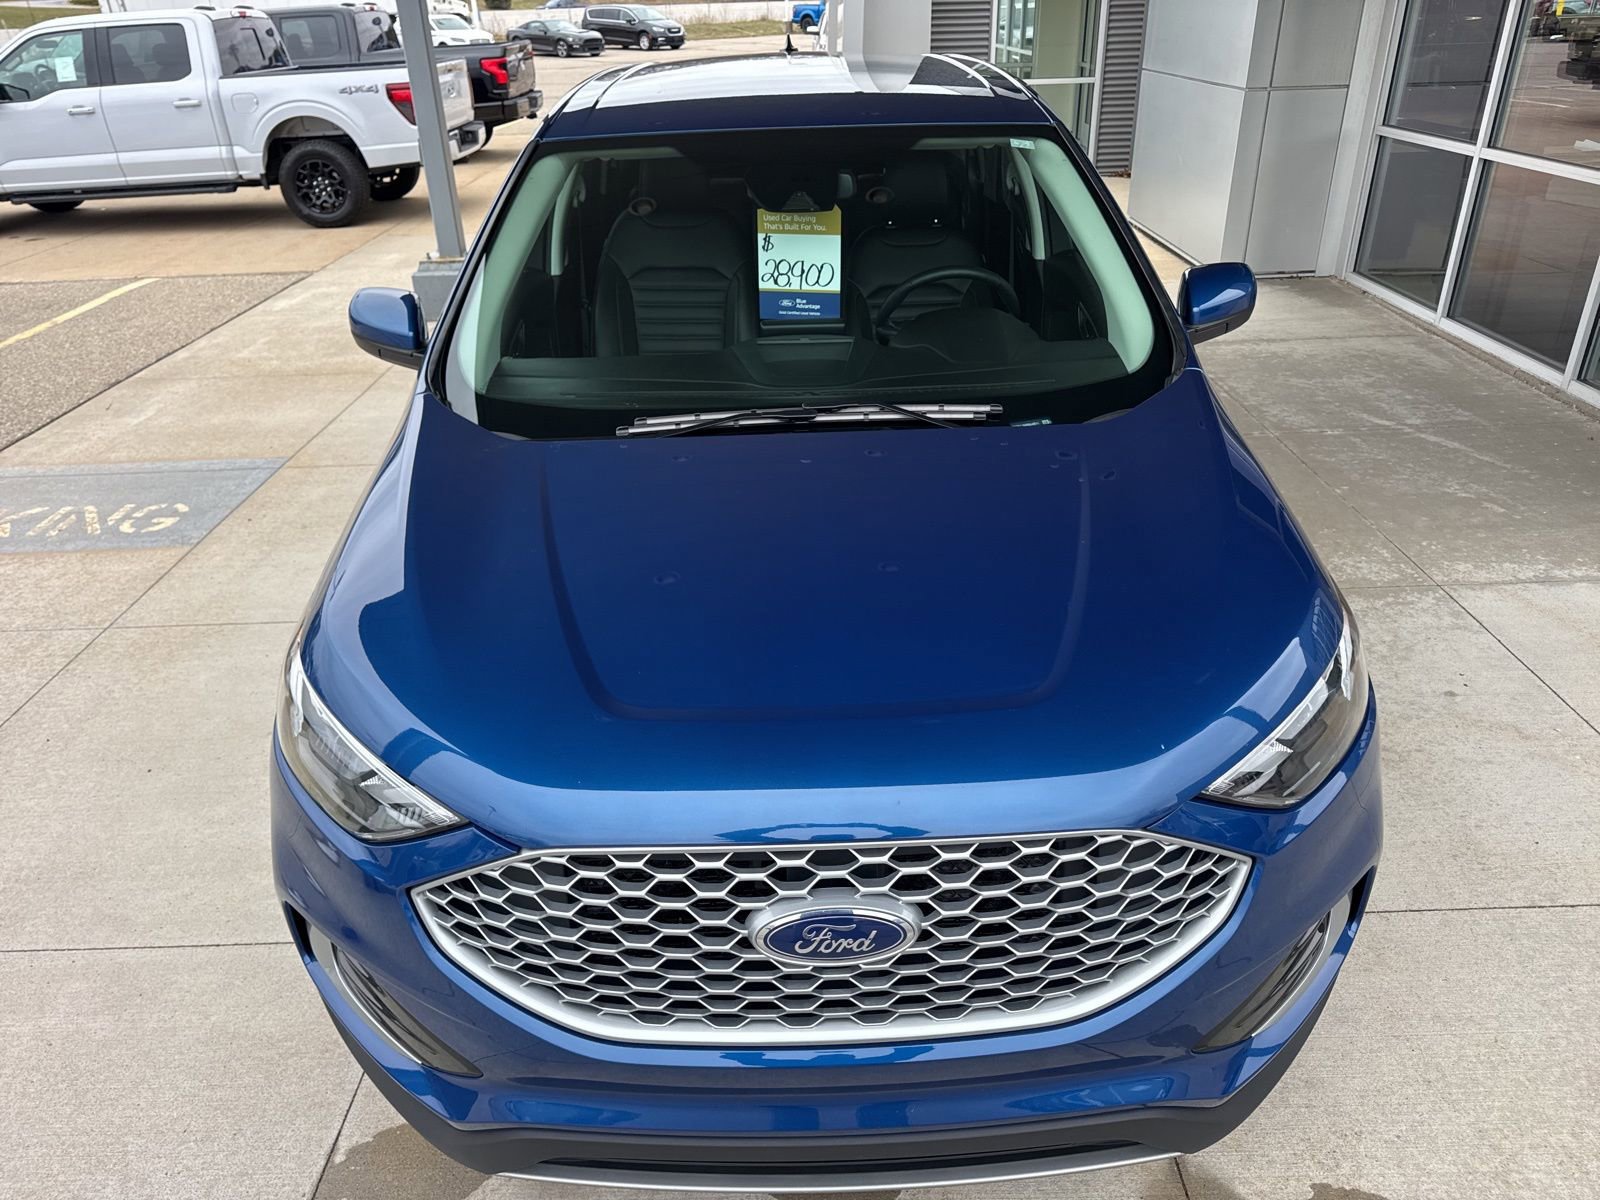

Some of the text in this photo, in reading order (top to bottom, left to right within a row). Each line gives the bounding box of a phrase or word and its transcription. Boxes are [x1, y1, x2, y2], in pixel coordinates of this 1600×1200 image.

[763, 214, 816, 223] Used Car Buying
[764, 222, 783, 230] That's
[784, 223, 799, 231] Built
[800, 223, 811, 231] For
[762, 233, 774, 252] $
[795, 923, 877, 953] Ford
